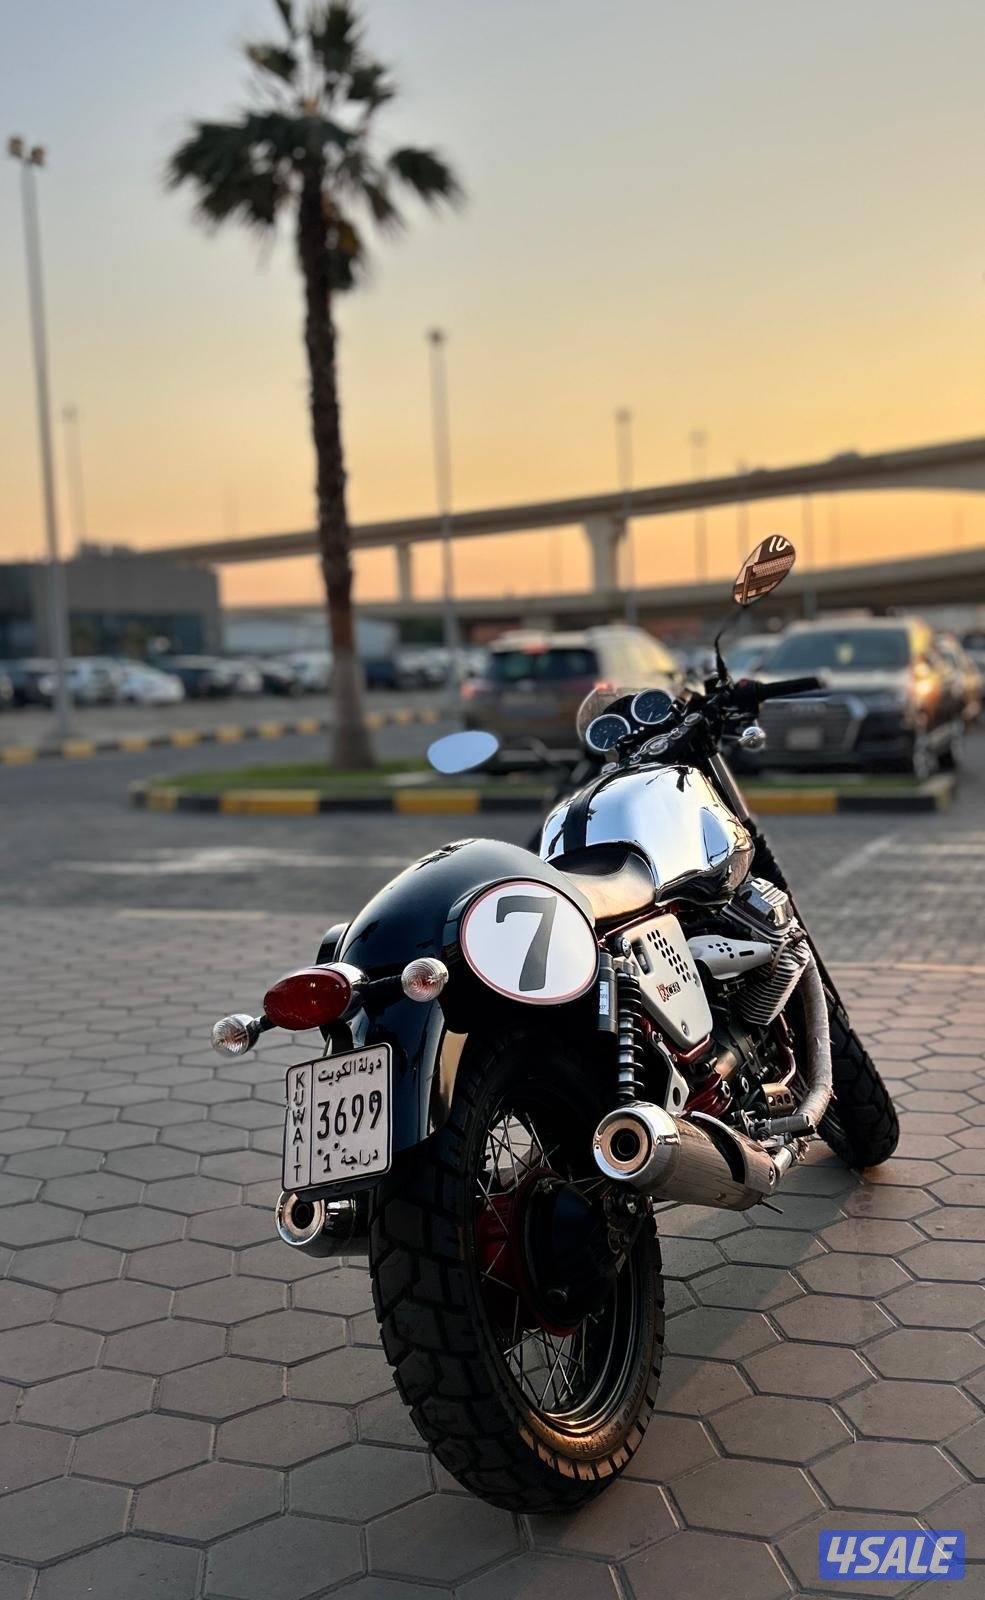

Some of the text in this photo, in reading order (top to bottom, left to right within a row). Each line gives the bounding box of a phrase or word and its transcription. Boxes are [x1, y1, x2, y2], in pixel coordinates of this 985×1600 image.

[496, 895, 558, 992] 7
[317, 1056, 382, 1086] دولة الكويت
[292, 1071, 306, 1183] KUWAIT
[316, 1090, 383, 1140] 3699
[340, 1148, 379, 1170] دراجة
